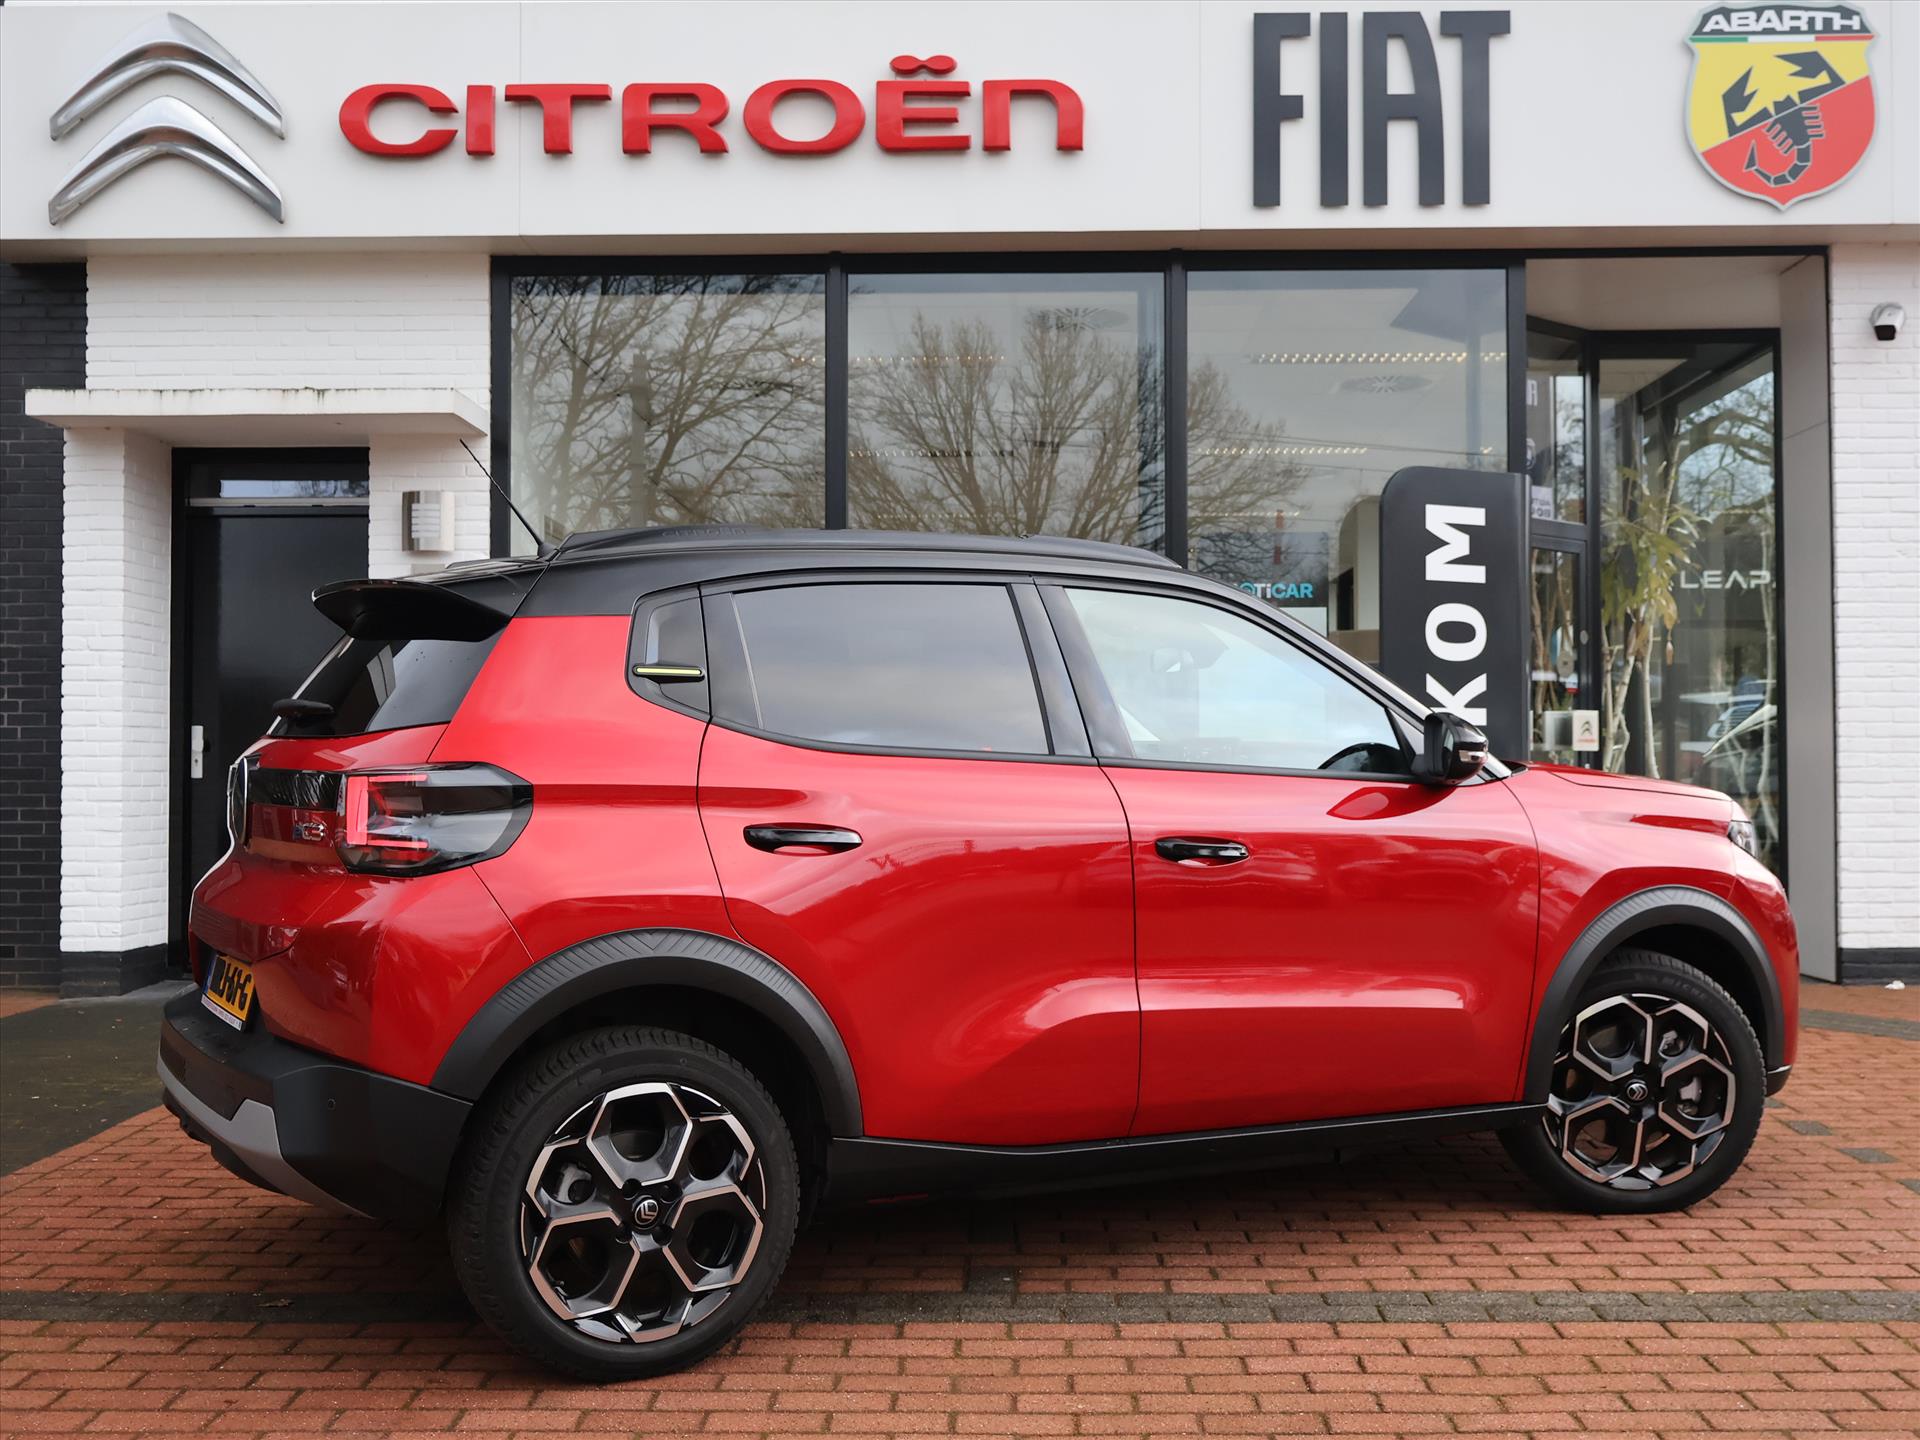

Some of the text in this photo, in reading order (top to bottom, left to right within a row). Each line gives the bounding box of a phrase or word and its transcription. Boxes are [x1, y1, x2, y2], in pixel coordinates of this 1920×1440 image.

[1702, 9, 1861, 33] ABARTH
[338, 54, 1085, 158] CITROËN
[1253, 10, 1511, 207] FIAT
[1680, 570, 1776, 589] LEAP
